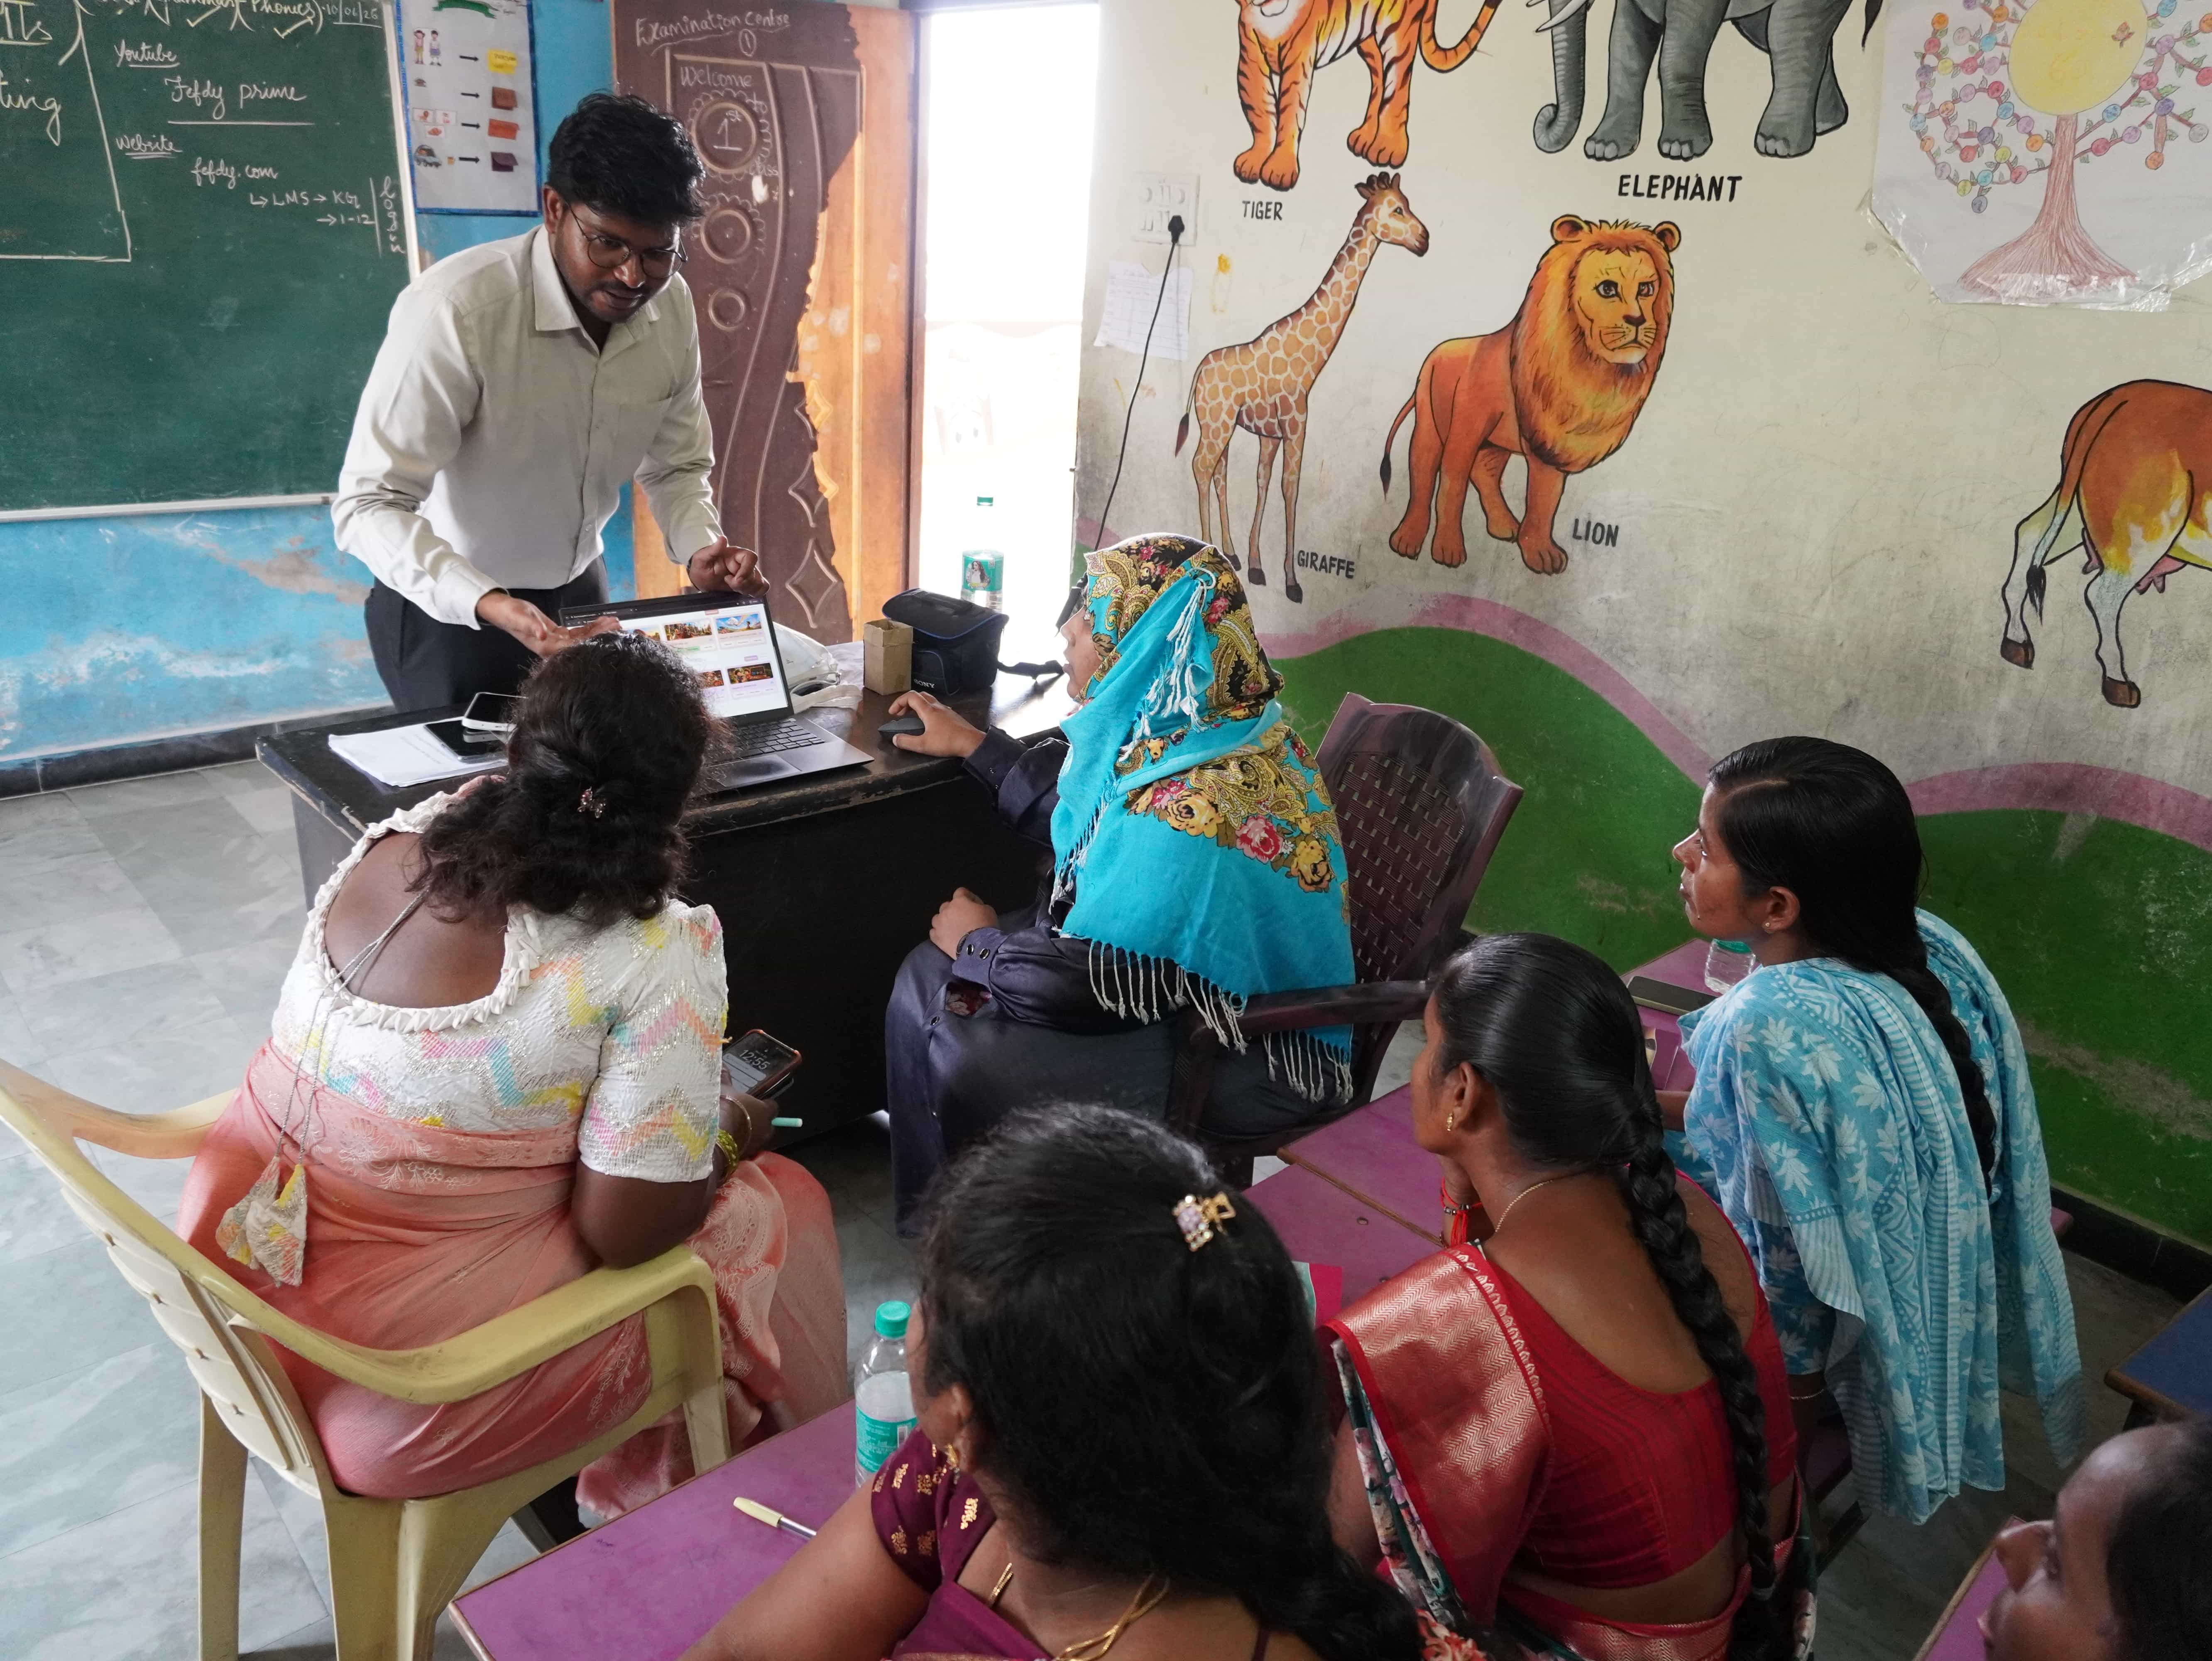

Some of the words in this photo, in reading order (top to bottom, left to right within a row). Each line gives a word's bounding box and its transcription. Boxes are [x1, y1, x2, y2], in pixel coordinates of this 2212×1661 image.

[636, 10, 741, 47] Examination
[114, 40, 177, 67] Youtube
[680, 64, 752, 87] Welcome
[240, 81, 308, 109] prime
[273, 193, 310, 206] LMS
[1618, 174, 1742, 202] ELEPHANT
[1242, 201, 1282, 220] TIGER
[1572, 519, 1619, 547] LION
[1297, 550, 1355, 579] GIRAFFE
[914, 679, 934, 688] SONY
[739, 1050, 770, 1070] 12:55
